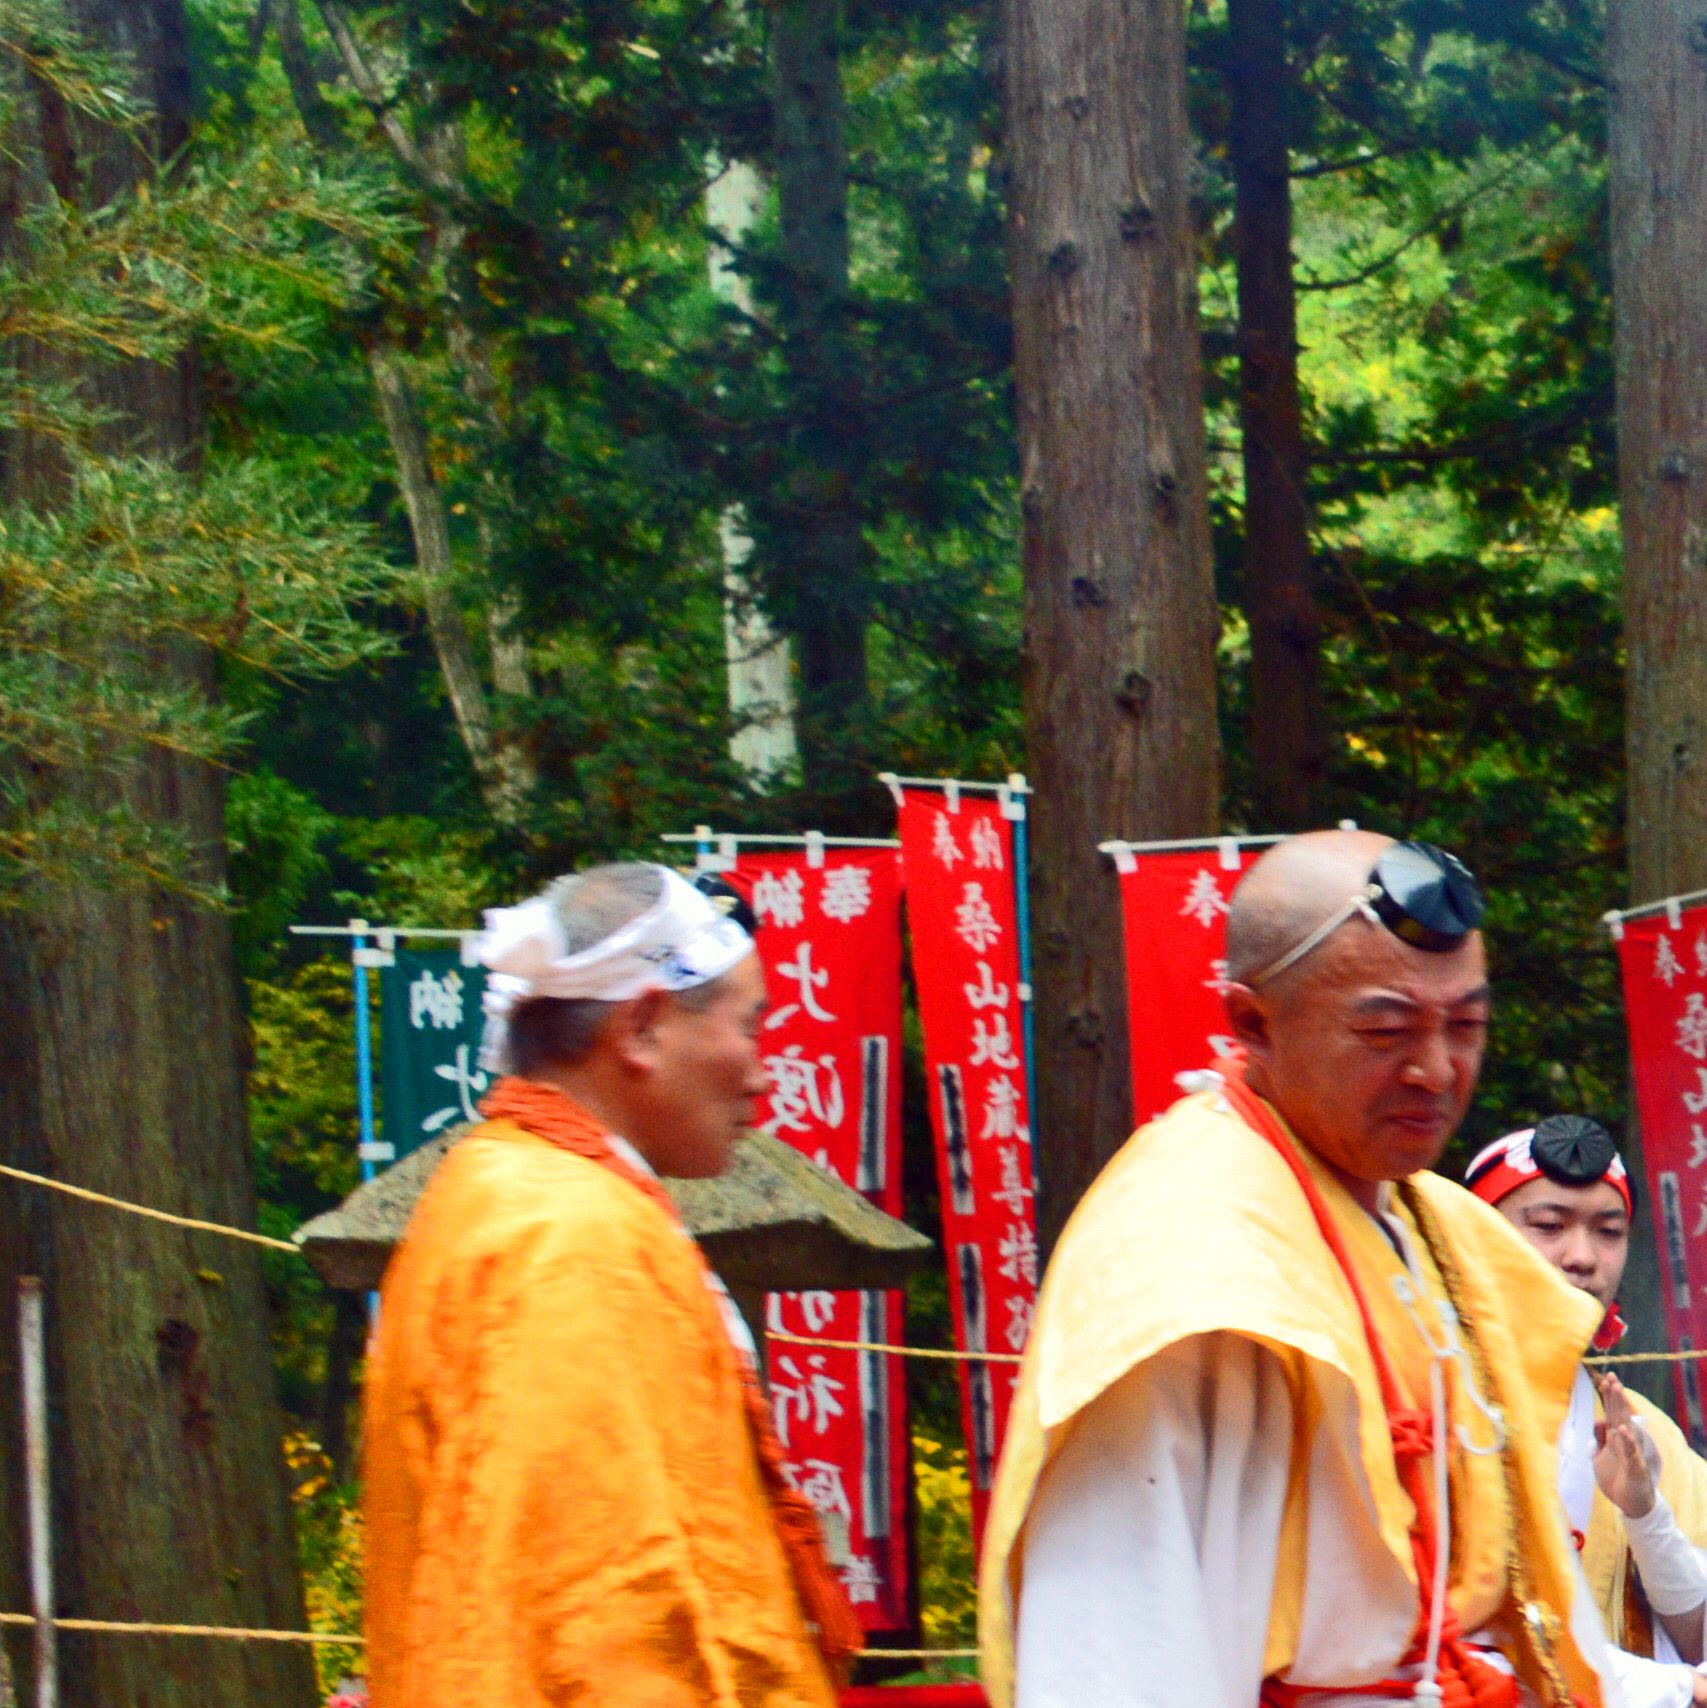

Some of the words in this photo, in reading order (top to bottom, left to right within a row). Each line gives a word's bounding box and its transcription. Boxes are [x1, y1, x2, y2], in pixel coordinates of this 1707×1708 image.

[932, 811, 1004, 873] 奉納
[1178, 868, 1232, 928] 奉
[953, 881, 1039, 1388] 桑山地蔵尊特別
